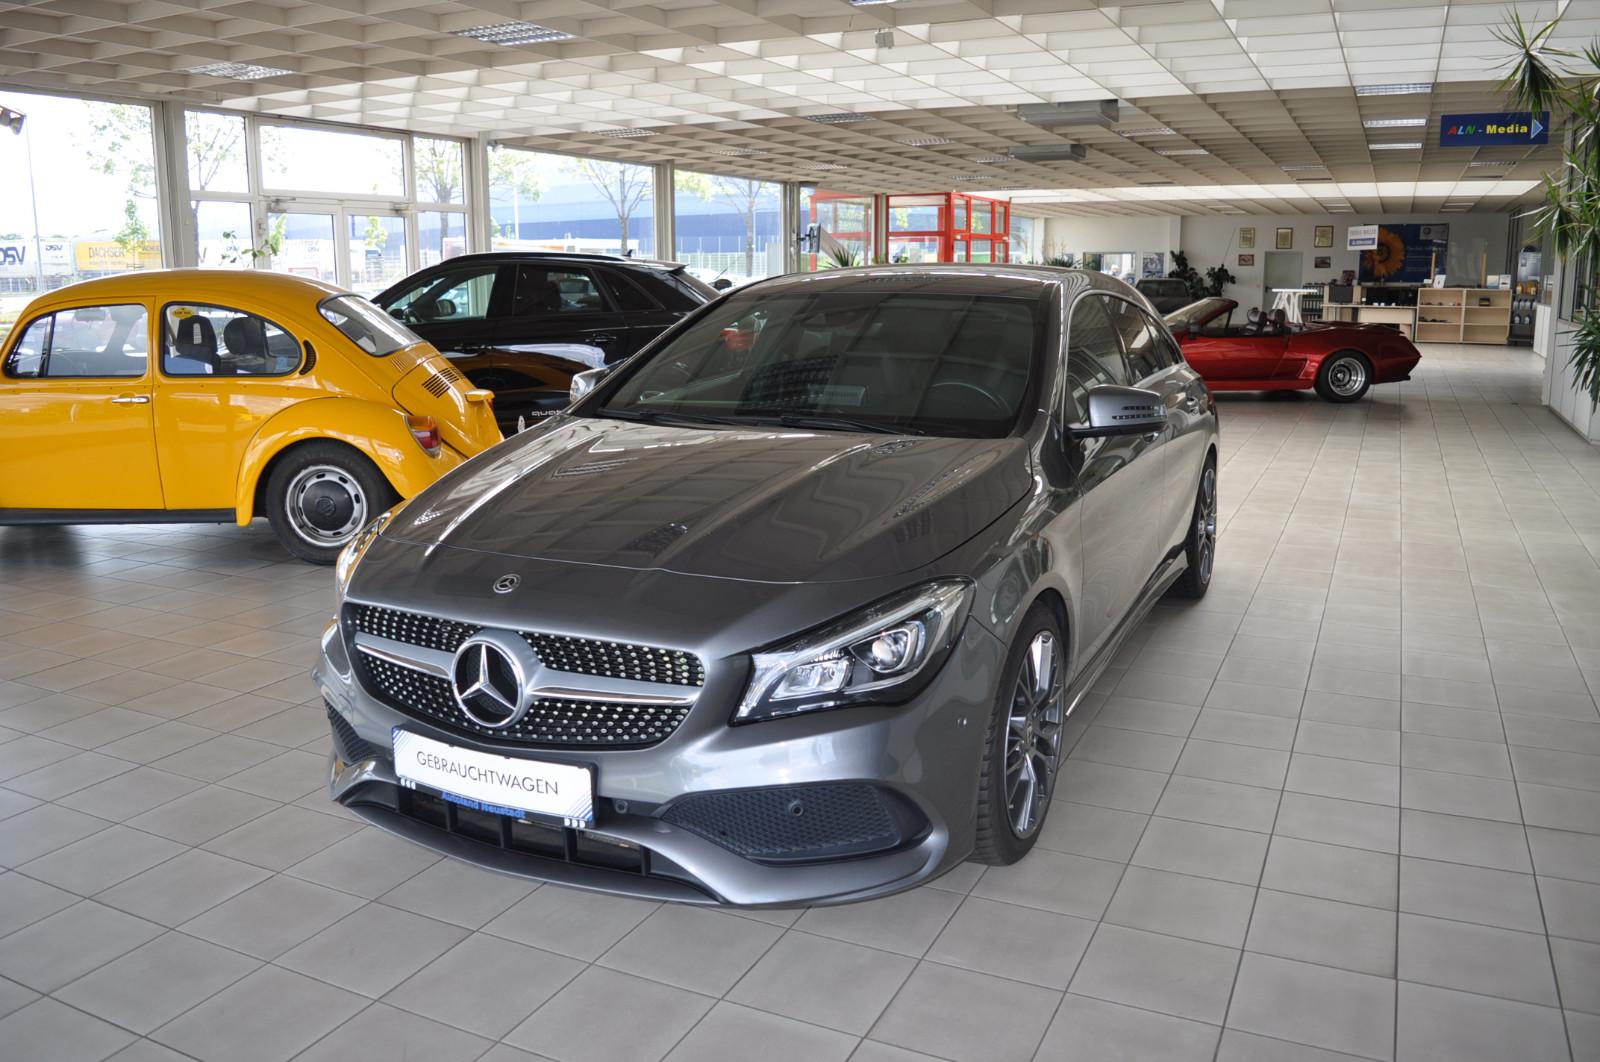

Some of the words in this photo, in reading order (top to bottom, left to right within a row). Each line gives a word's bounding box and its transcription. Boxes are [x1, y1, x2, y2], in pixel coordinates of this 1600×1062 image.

[1449, 124, 1476, 135] ALN
[1486, 124, 1528, 134] Media
[88, 247, 125, 258] DACHSER
[416, 751, 558, 795] GEBRAUCHTWAGEN
[481, 803, 526, 818] Neustadt
